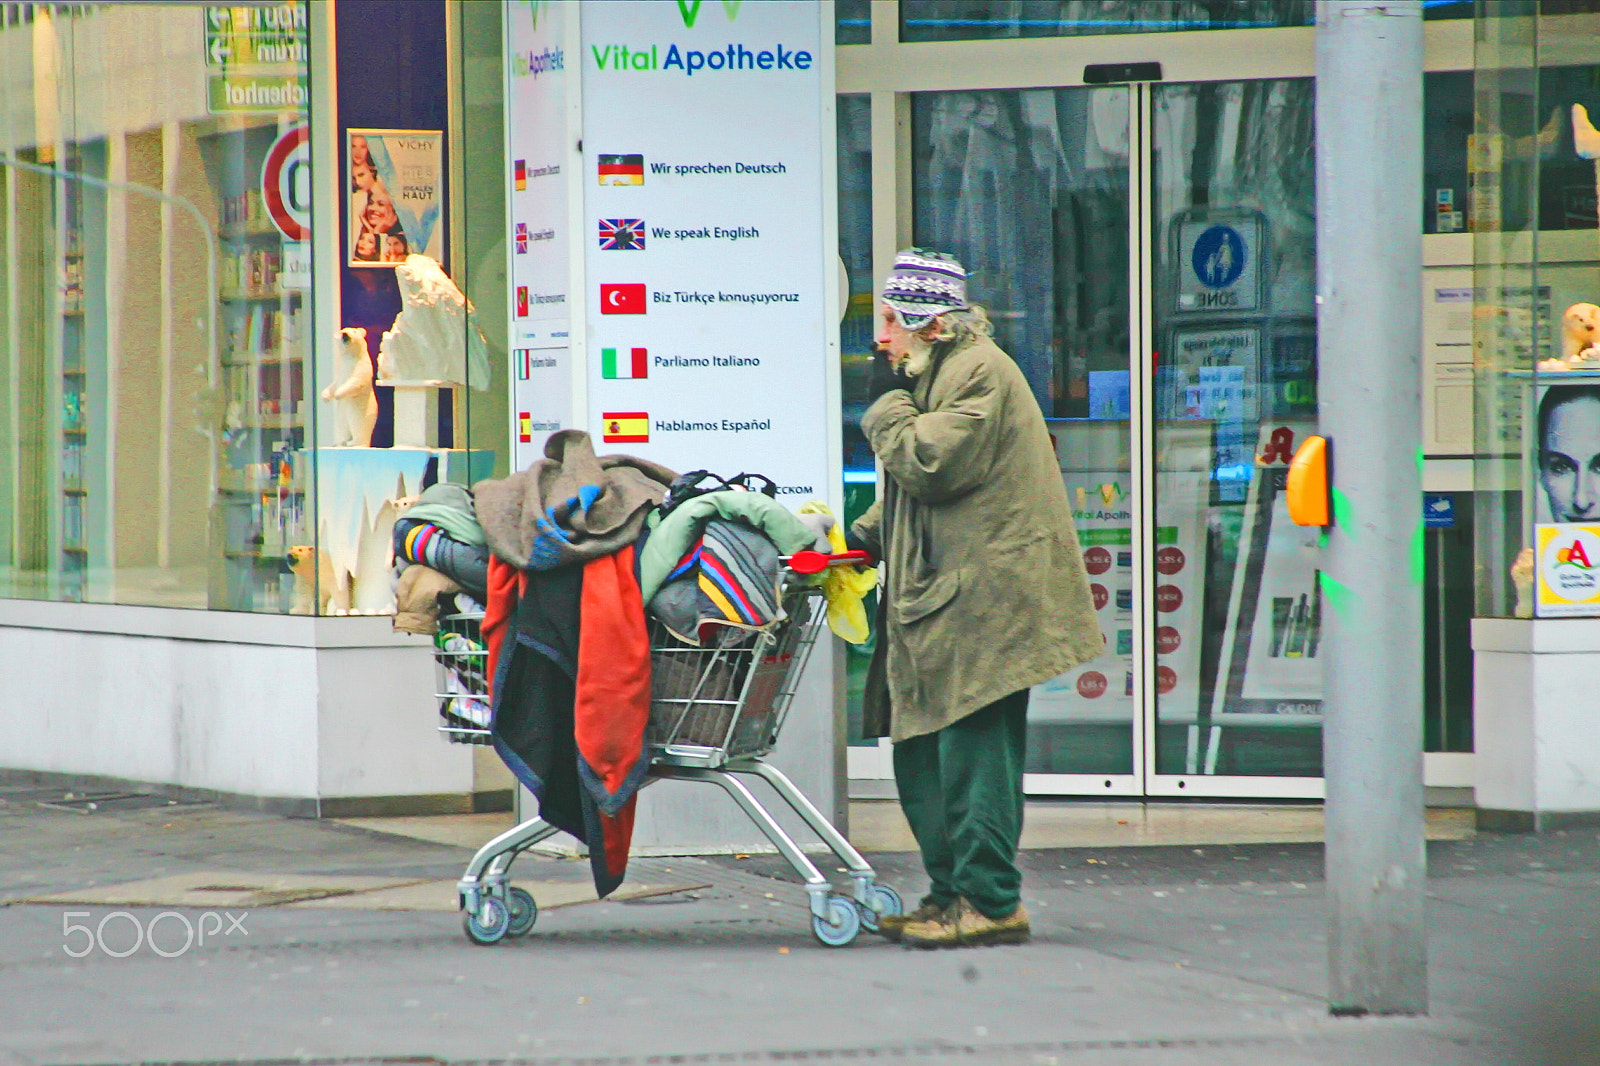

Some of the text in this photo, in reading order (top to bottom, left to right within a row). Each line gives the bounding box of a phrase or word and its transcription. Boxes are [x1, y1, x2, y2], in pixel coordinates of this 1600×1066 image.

[592, 43, 813, 76] Vital Apotheke
[398, 140, 433, 150] VICHY
[650, 161, 787, 176] Wir sprechen Deutsch
[402, 191, 433, 200] HAUT
[651, 226, 760, 241] We speak English
[653, 291, 800, 306] Biz Türkçe konuşuyoruz
[654, 355, 761, 367] Parliamo Italiano
[655, 418, 771, 433] Hablamos Español
[1096, 510, 1132, 521] Apoth
